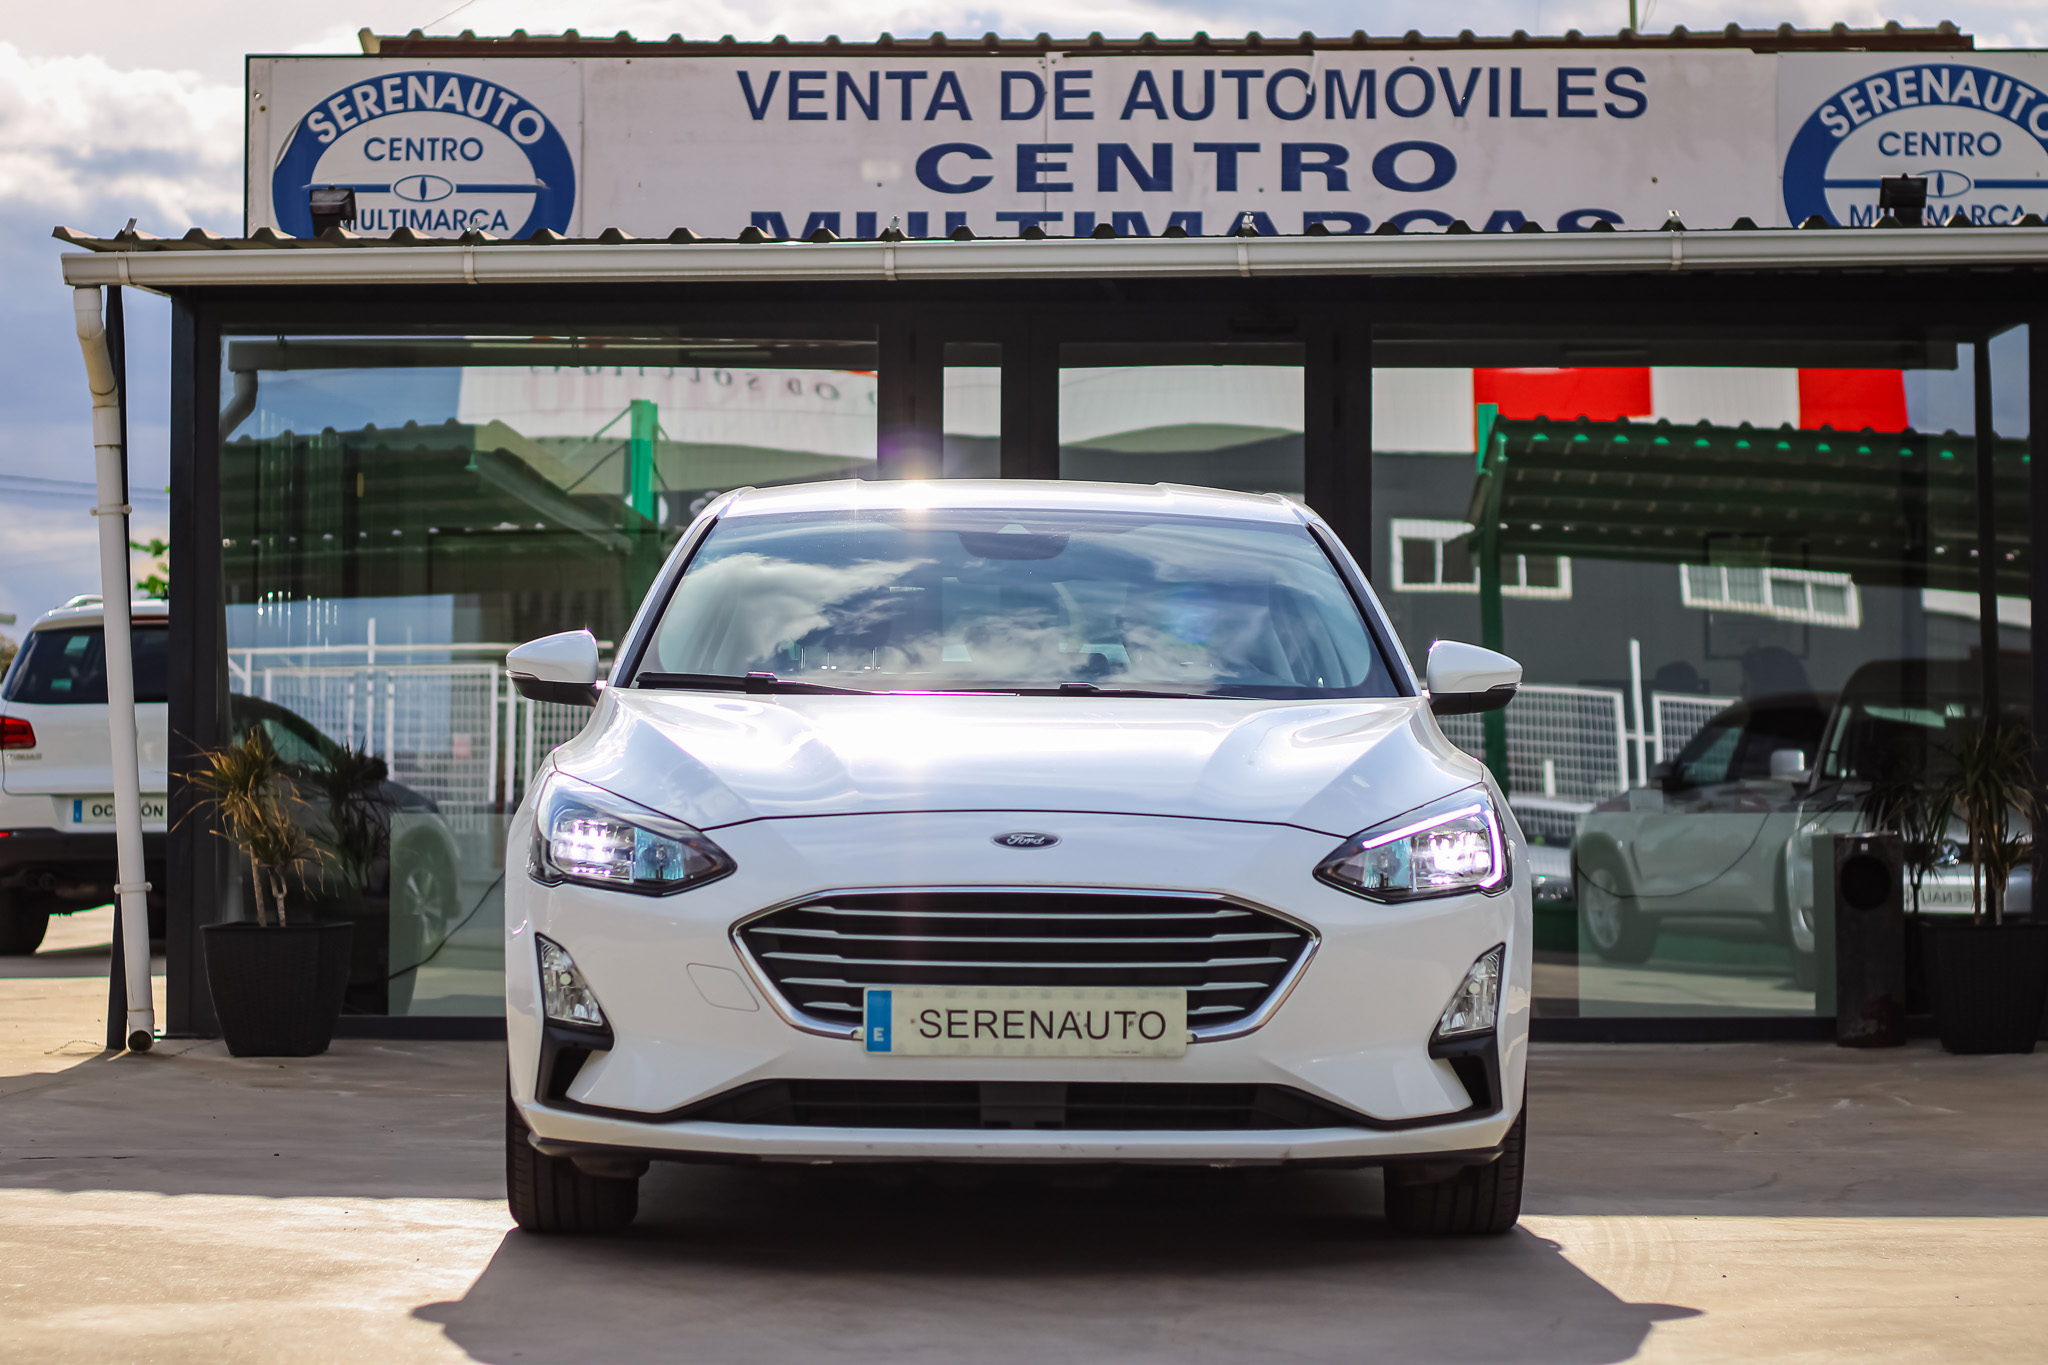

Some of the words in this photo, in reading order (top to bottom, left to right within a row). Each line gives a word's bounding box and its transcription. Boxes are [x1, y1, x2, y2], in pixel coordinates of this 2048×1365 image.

[737, 70, 973, 121] VENTA
[1000, 69, 1095, 120] DE
[1119, 66, 1648, 121] AUTOMOVILES
[307, 75, 545, 144] SERENAUTO
[364, 136, 484, 162] CENTRO
[1878, 131, 2003, 157] CENTRO
[915, 139, 1458, 194] CENTRO
[341, 208, 509, 231] ULTIMARCA
[1850, 204, 2026, 228] MMARCA
[92, 802, 163, 817] OCÓN
[1006, 833, 1046, 845] Ford
[873, 1027, 885, 1042] E
[919, 1009, 1167, 1040] SERENAUTO
